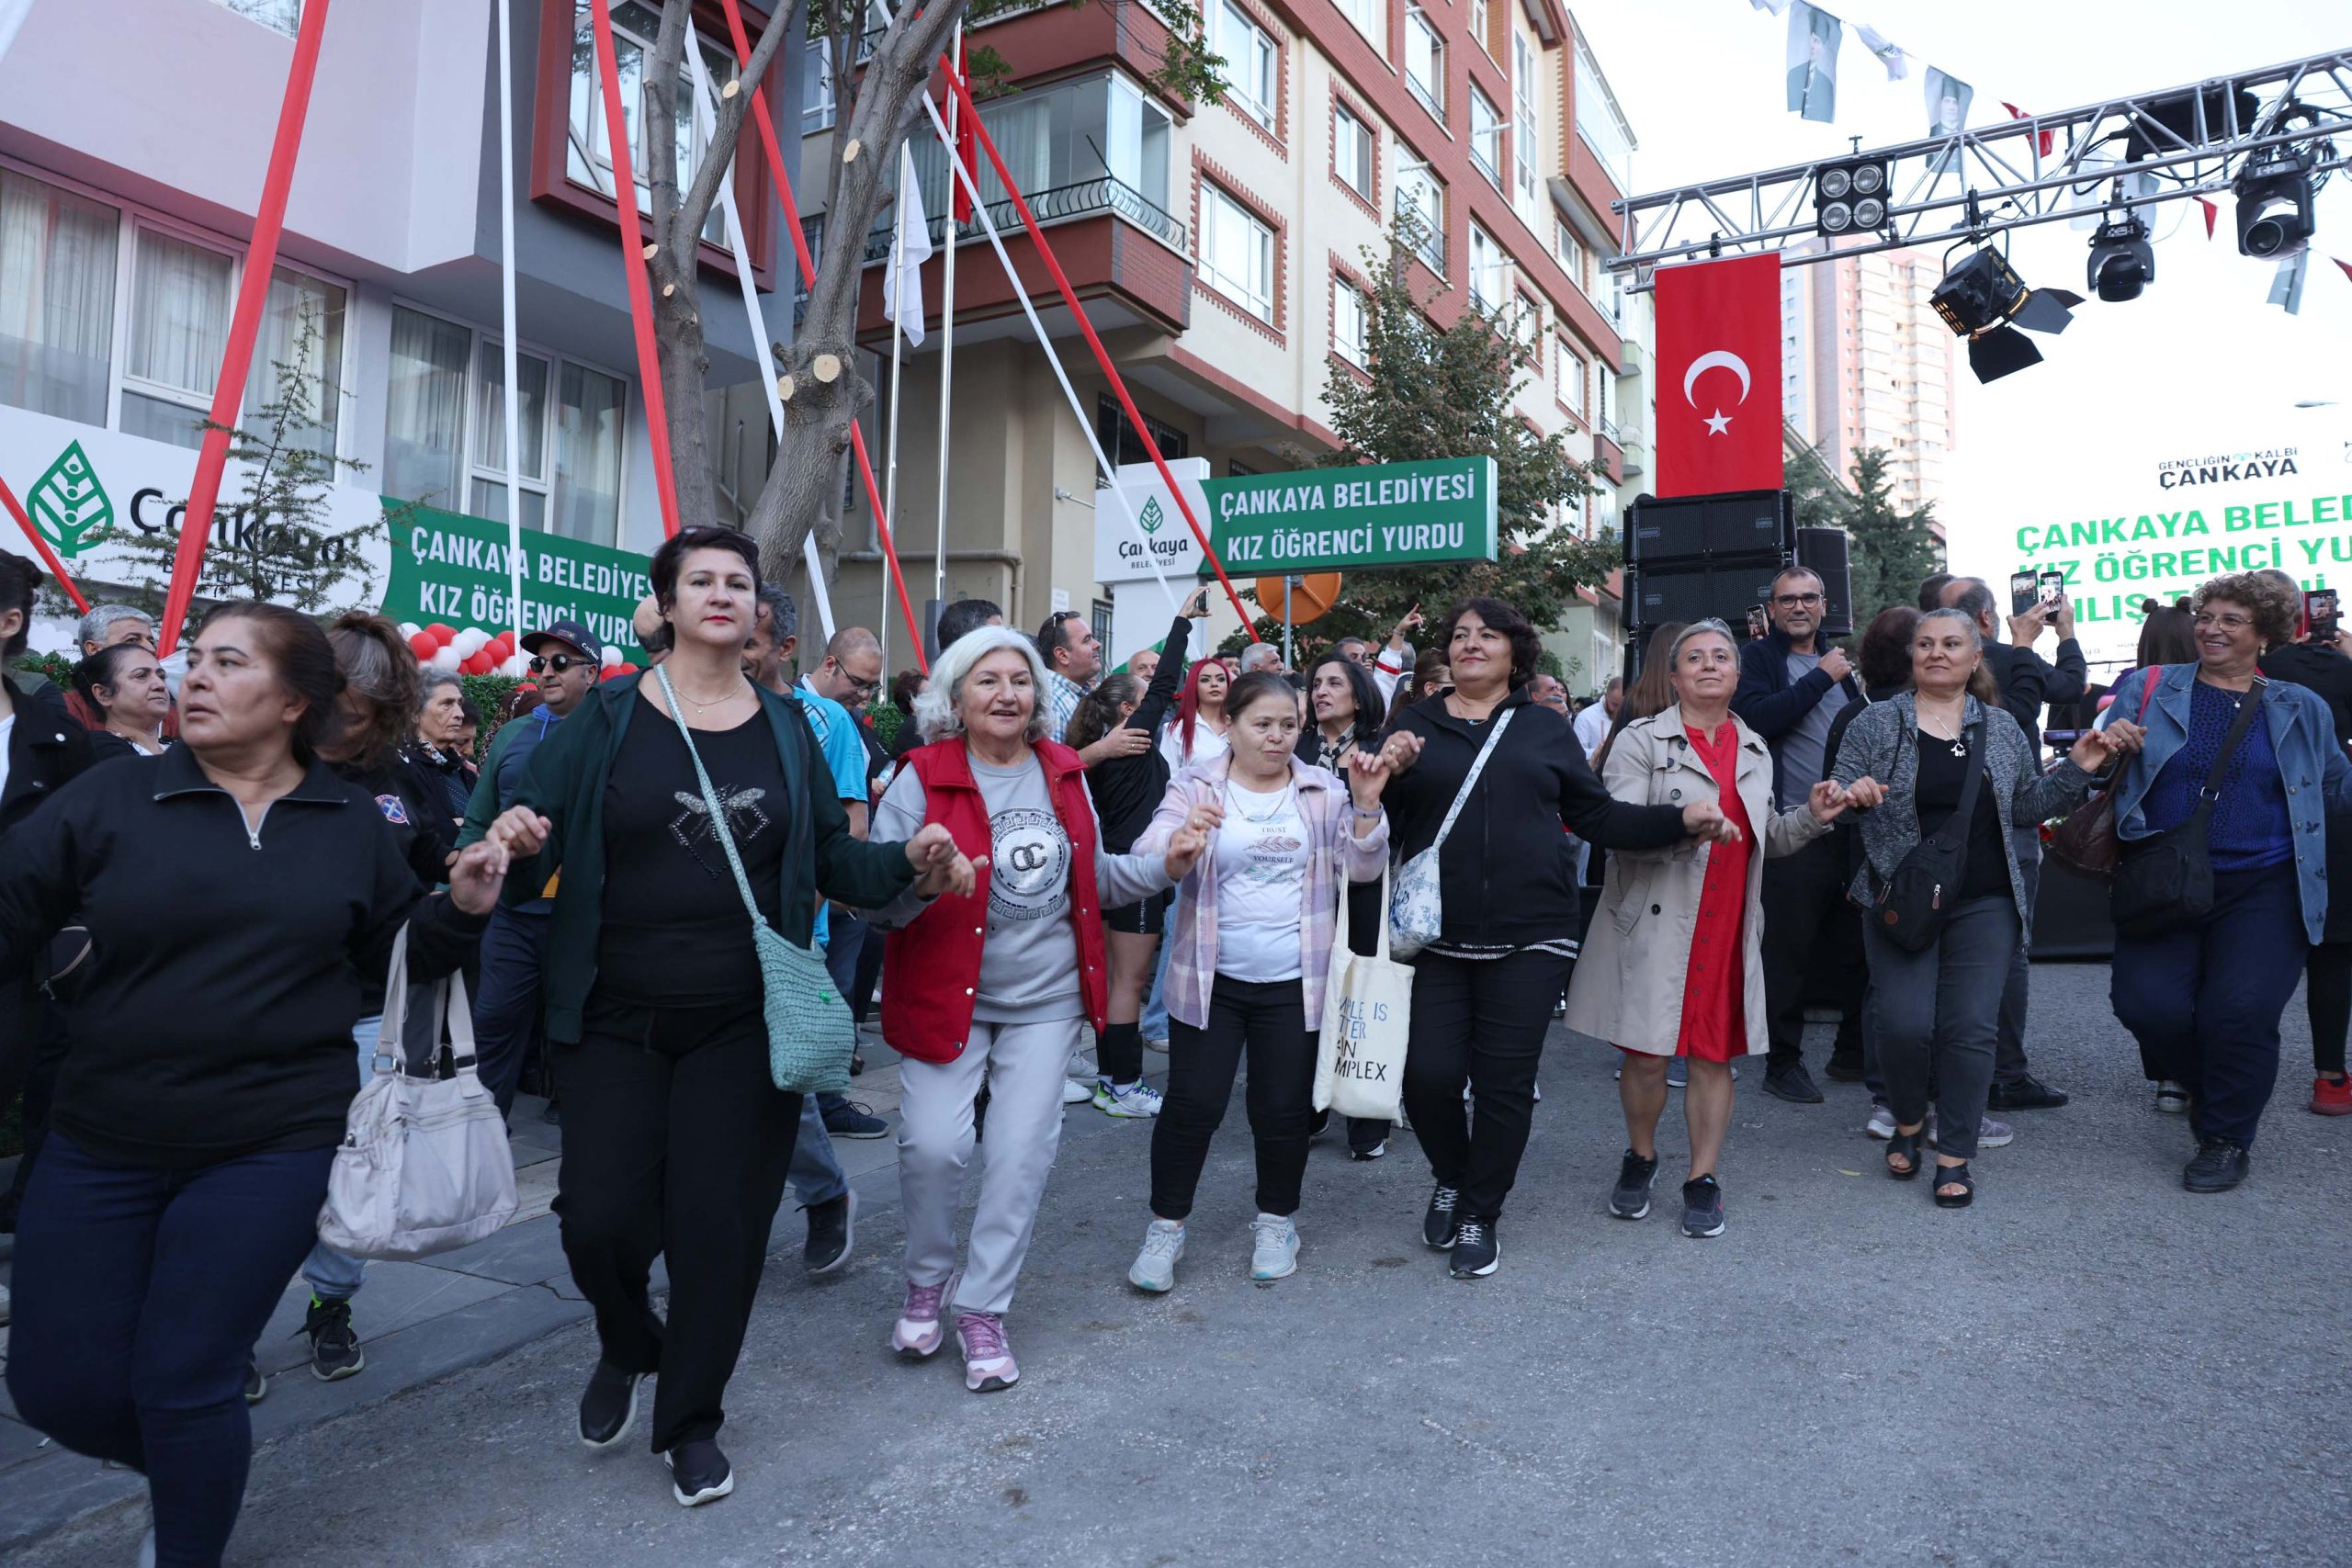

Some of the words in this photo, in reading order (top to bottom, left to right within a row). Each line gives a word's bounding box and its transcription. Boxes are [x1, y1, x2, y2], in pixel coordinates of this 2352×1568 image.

[2255, 446, 2298, 460] KALBİ
[2159, 458, 2298, 491] ÇANKAYA
[1220, 485, 1325, 522] ÇANKAYA
[1334, 468, 1474, 508] BELEDİYESİ
[1227, 534, 1263, 561] KIZ
[1272, 523, 1373, 559] ÖĞRENCİ
[1382, 522, 1464, 552] YURDU
[2017, 510, 2209, 557] ÇANKAYA
[411, 526, 530, 580] ÇANKAYA
[538, 553, 656, 602] BELEDİYE
[1131, 558, 1176, 570] BELEYESİ
[2094, 536, 2282, 582] ÖĞRENCİ
[420, 581, 462, 618] KIZ
[2074, 592, 2149, 625] ILIŞ
[1252, 855, 1295, 864] YOURSELF
[1340, 1014, 1366, 1039] TTER
[1373, 1002, 1388, 1021] IS
[1334, 1056, 1387, 1082] MPLEX
